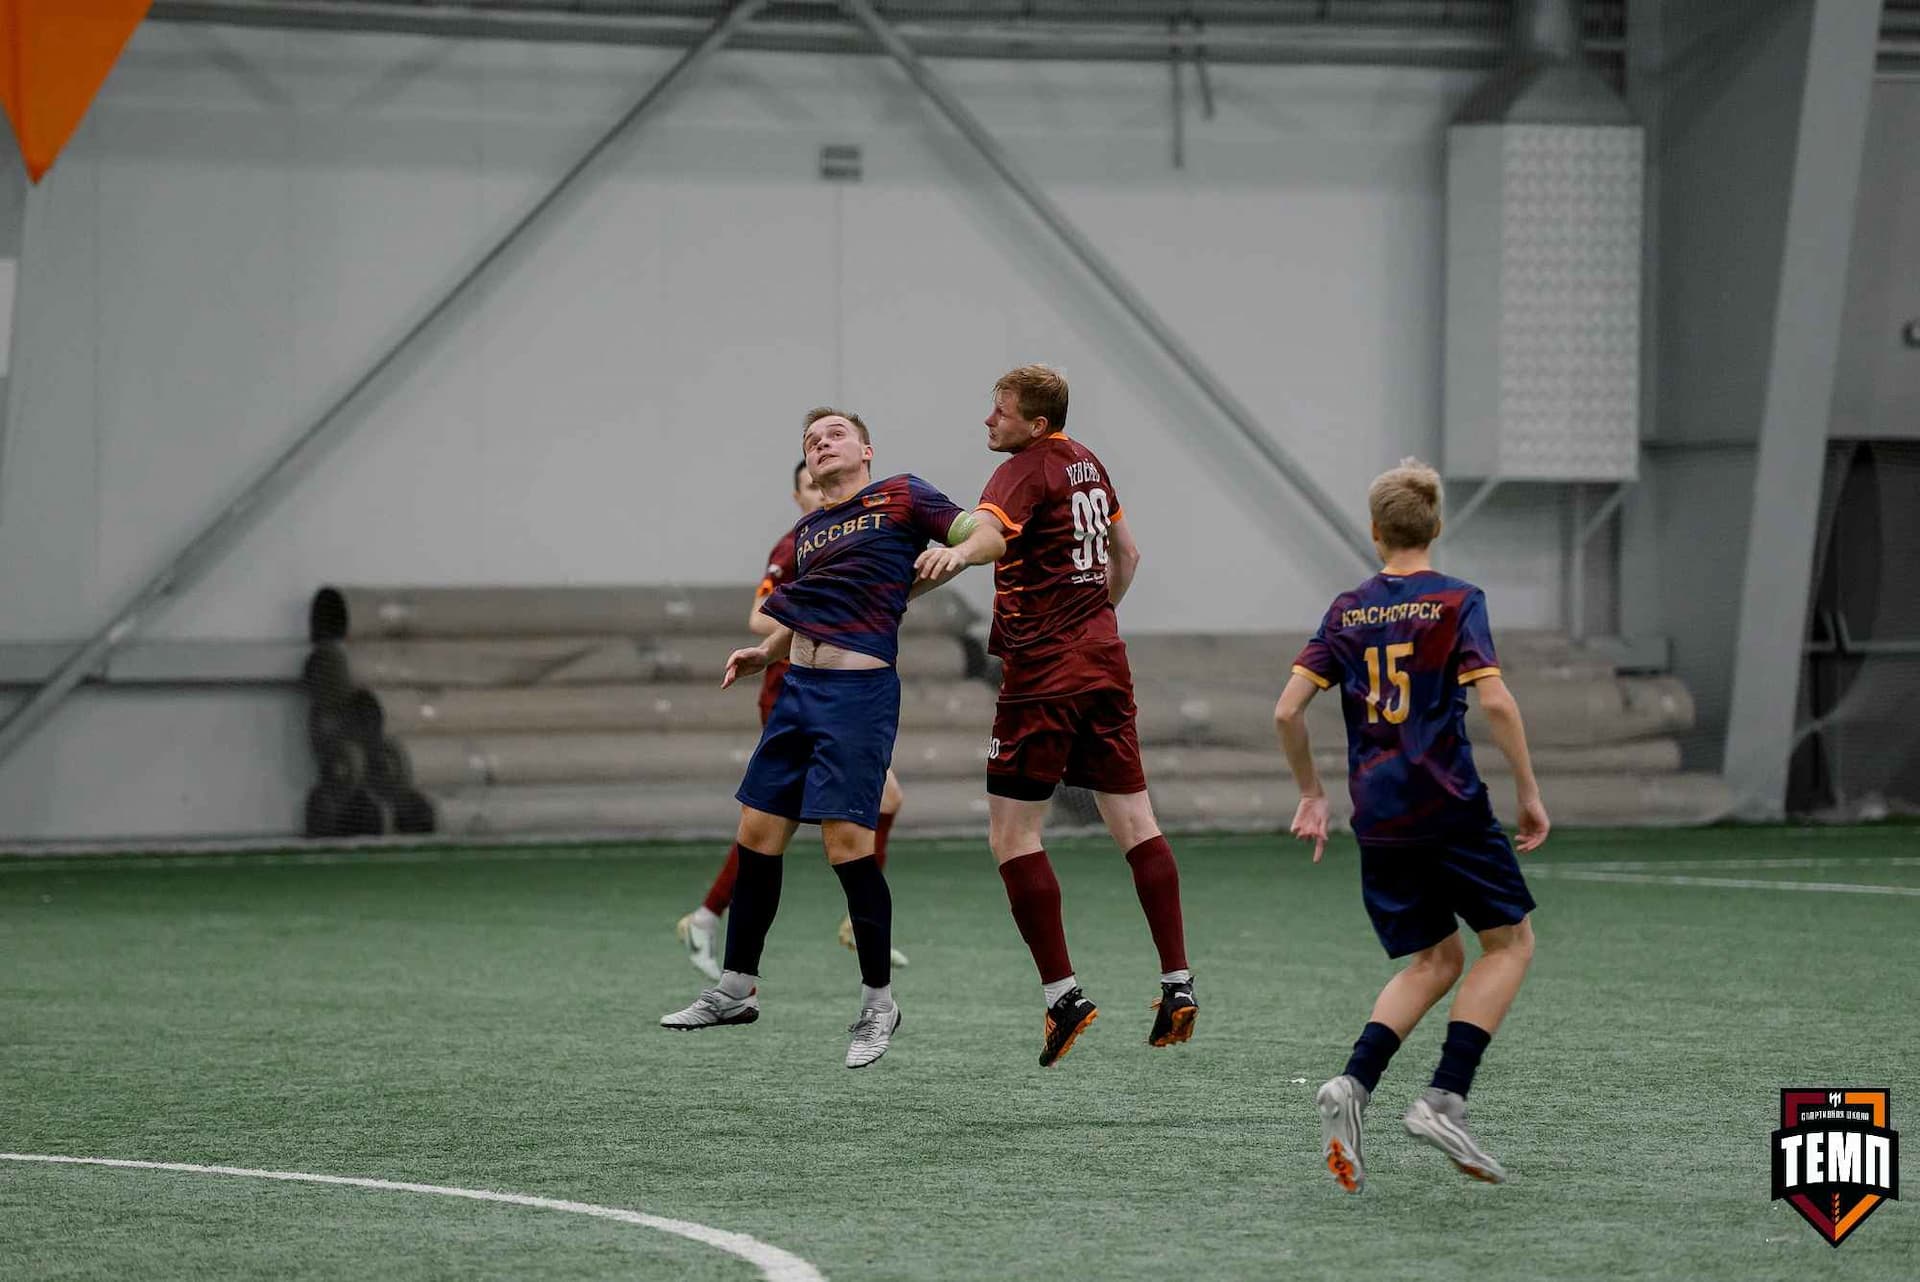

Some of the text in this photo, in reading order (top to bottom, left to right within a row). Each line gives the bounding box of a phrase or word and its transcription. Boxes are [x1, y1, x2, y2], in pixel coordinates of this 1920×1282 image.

[797, 513, 887, 567] РАССВЕТ
[1341, 601, 1443, 628] КРАСНОЯРСК
[1363, 642, 1414, 725] 15
[988, 736, 1001, 760] 0
